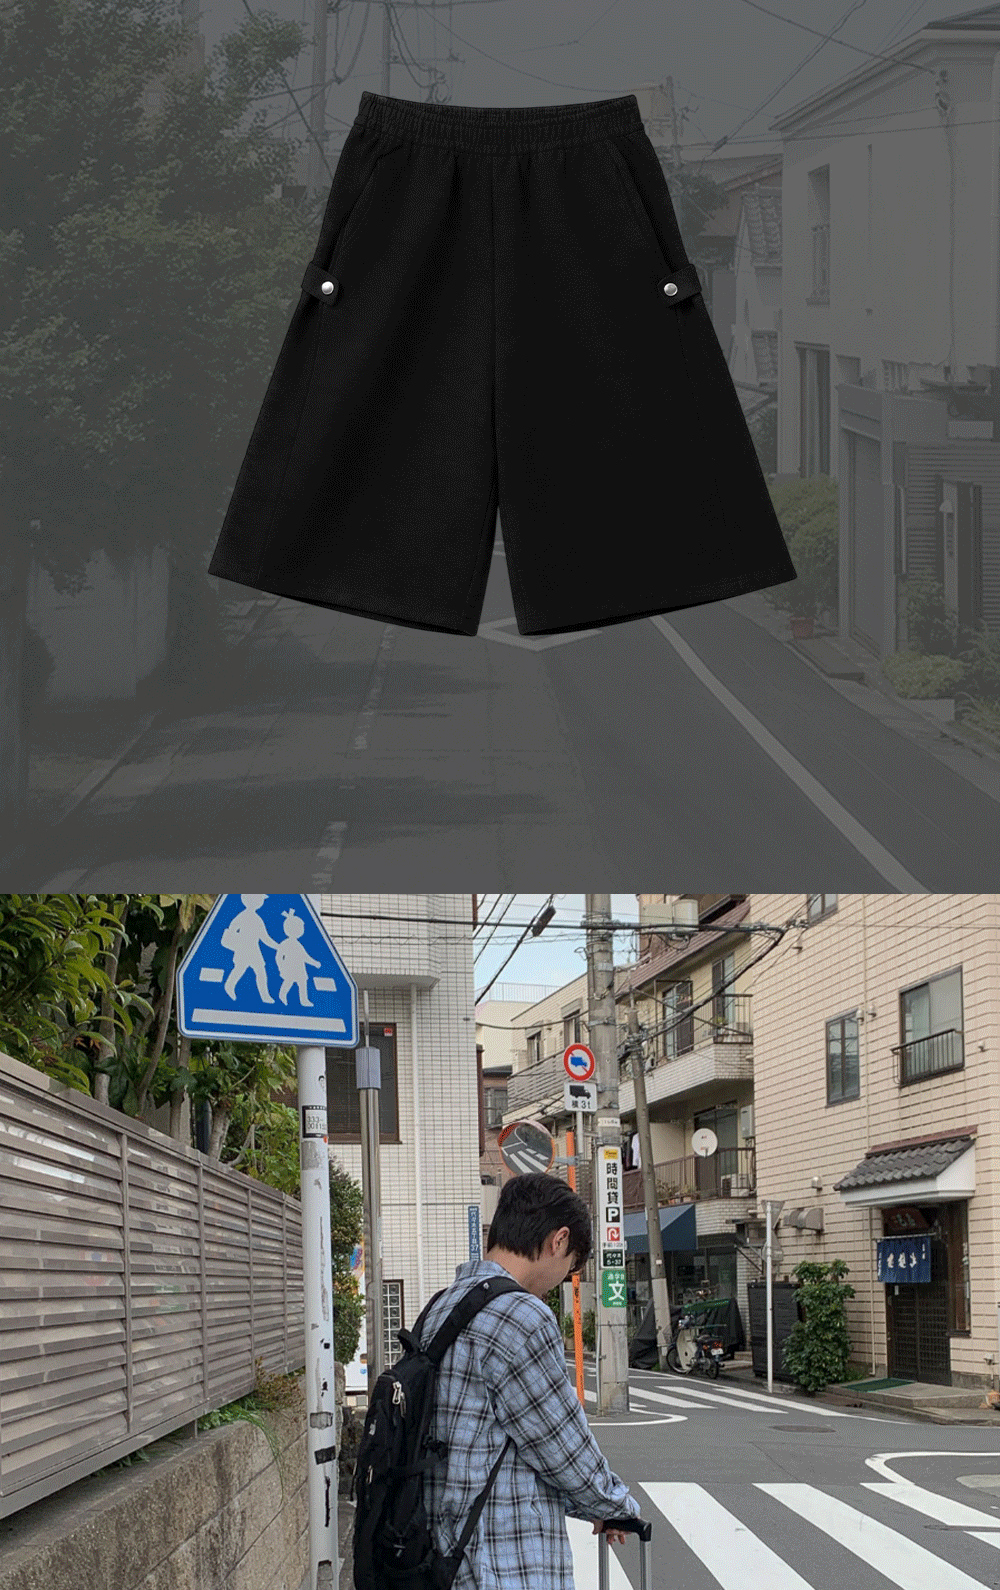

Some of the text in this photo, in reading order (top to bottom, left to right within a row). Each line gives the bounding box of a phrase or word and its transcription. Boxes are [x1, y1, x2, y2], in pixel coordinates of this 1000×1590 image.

[606, 1162, 619, 1205] 時間貸
[607, 1207, 619, 1222] P
[608, 1280, 625, 1301] 文
